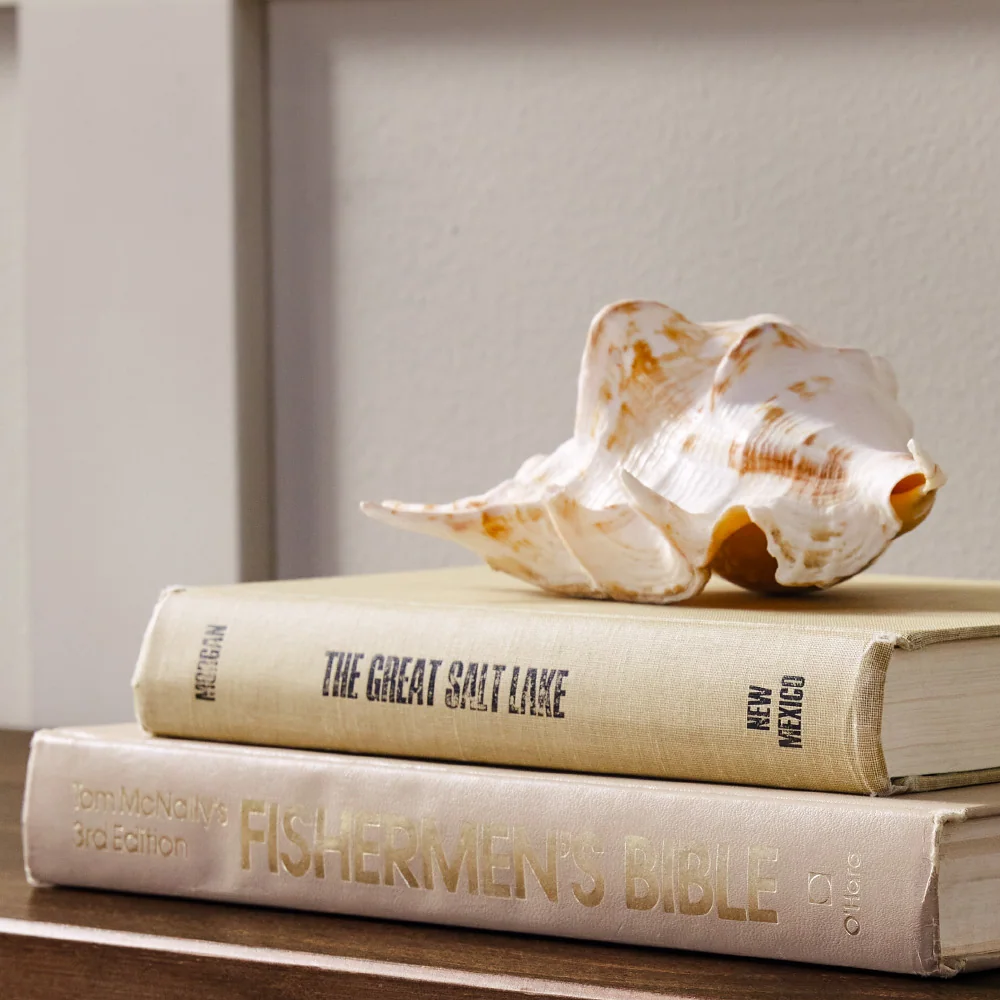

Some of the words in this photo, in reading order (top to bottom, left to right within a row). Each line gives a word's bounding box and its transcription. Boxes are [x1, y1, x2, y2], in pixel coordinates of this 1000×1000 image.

[195, 624, 227, 701] MORGAN
[322, 650, 364, 699] THE
[366, 653, 443, 706] GREAT
[444, 660, 506, 713] SALT
[508, 665, 570, 718] LAKE
[747, 685, 773, 730] NEW
[778, 675, 806, 749] MEXICO
[72, 781, 116, 814] Tom
[73, 821, 108, 850] 3rd
[112, 824, 188, 859] Edition
[240, 799, 605, 908] FISHERMEN'S
[624, 835, 779, 924] BIBLE
